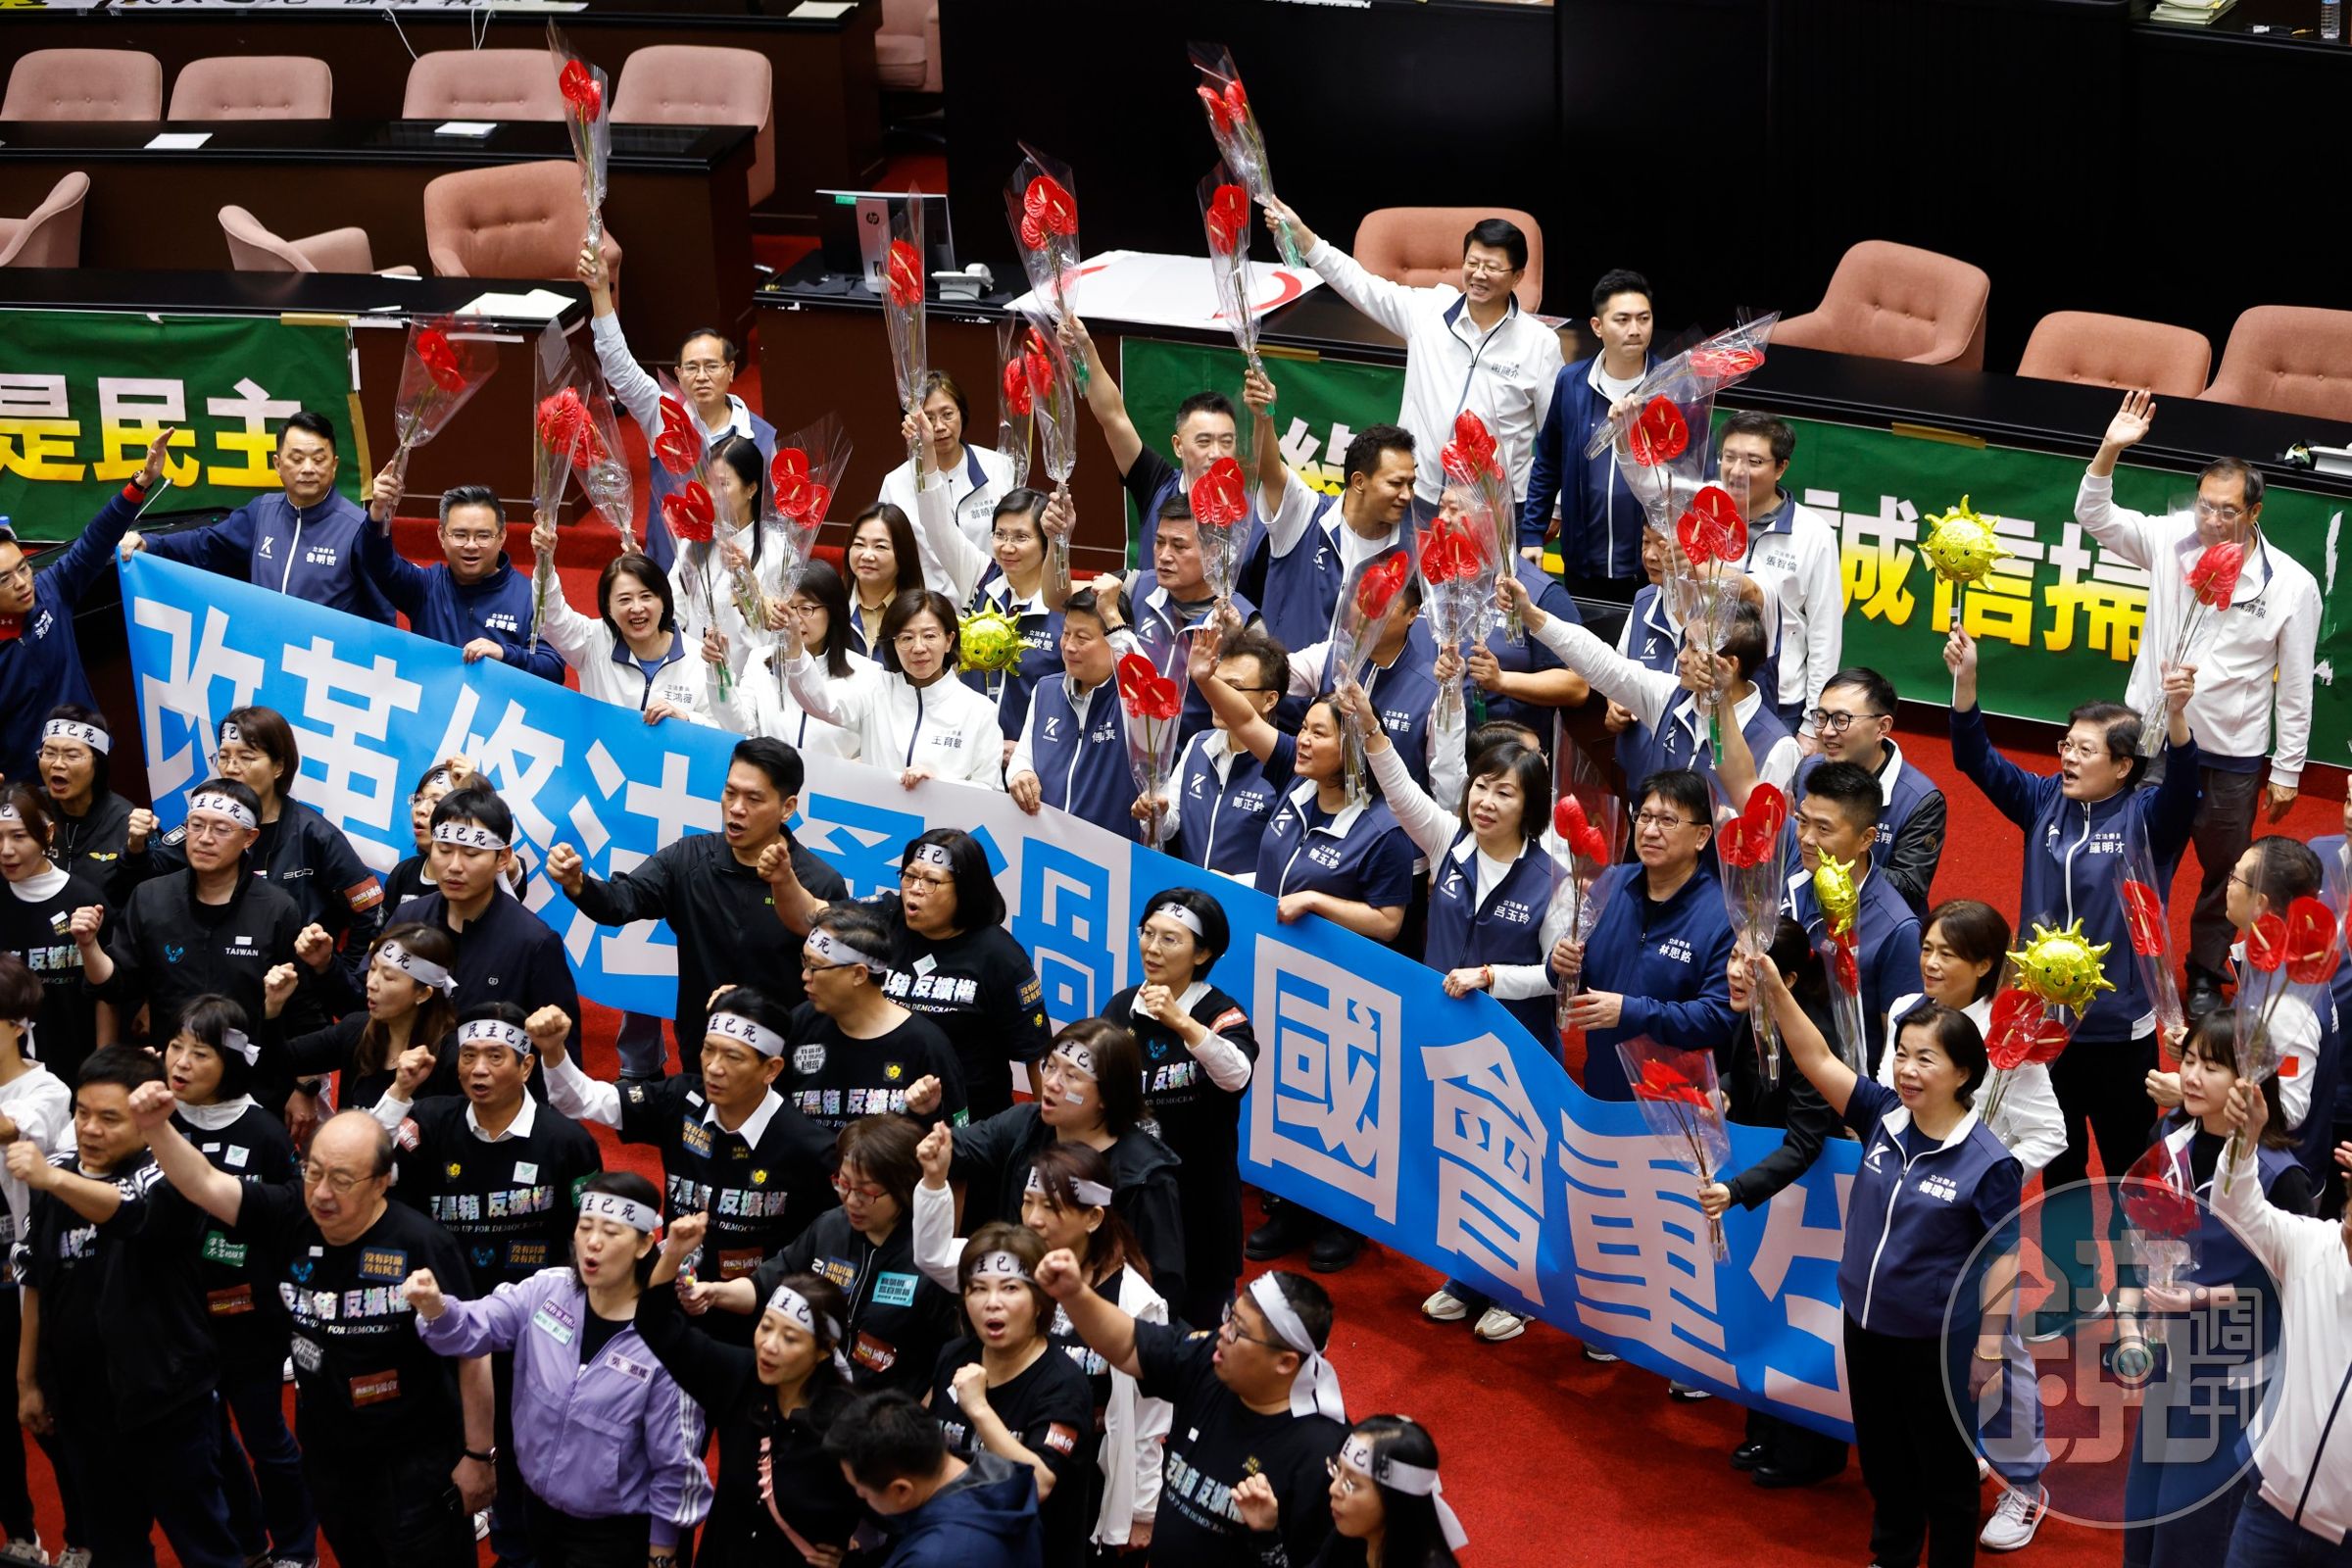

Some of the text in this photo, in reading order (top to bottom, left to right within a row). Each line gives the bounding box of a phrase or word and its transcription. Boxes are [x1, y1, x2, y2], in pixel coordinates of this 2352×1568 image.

[0, 373, 302, 488] 是民主
[133, 596, 723, 977] 改革修法
[1502, 900, 1529, 911] 立法委員
[1494, 906, 1530, 924] 呂玉玲
[224, 947, 259, 956] TAIWAN
[1668, 938, 1691, 949] 立法委員
[1658, 945, 1692, 963] 林思銘
[466, 1022, 529, 1052] 民主已死
